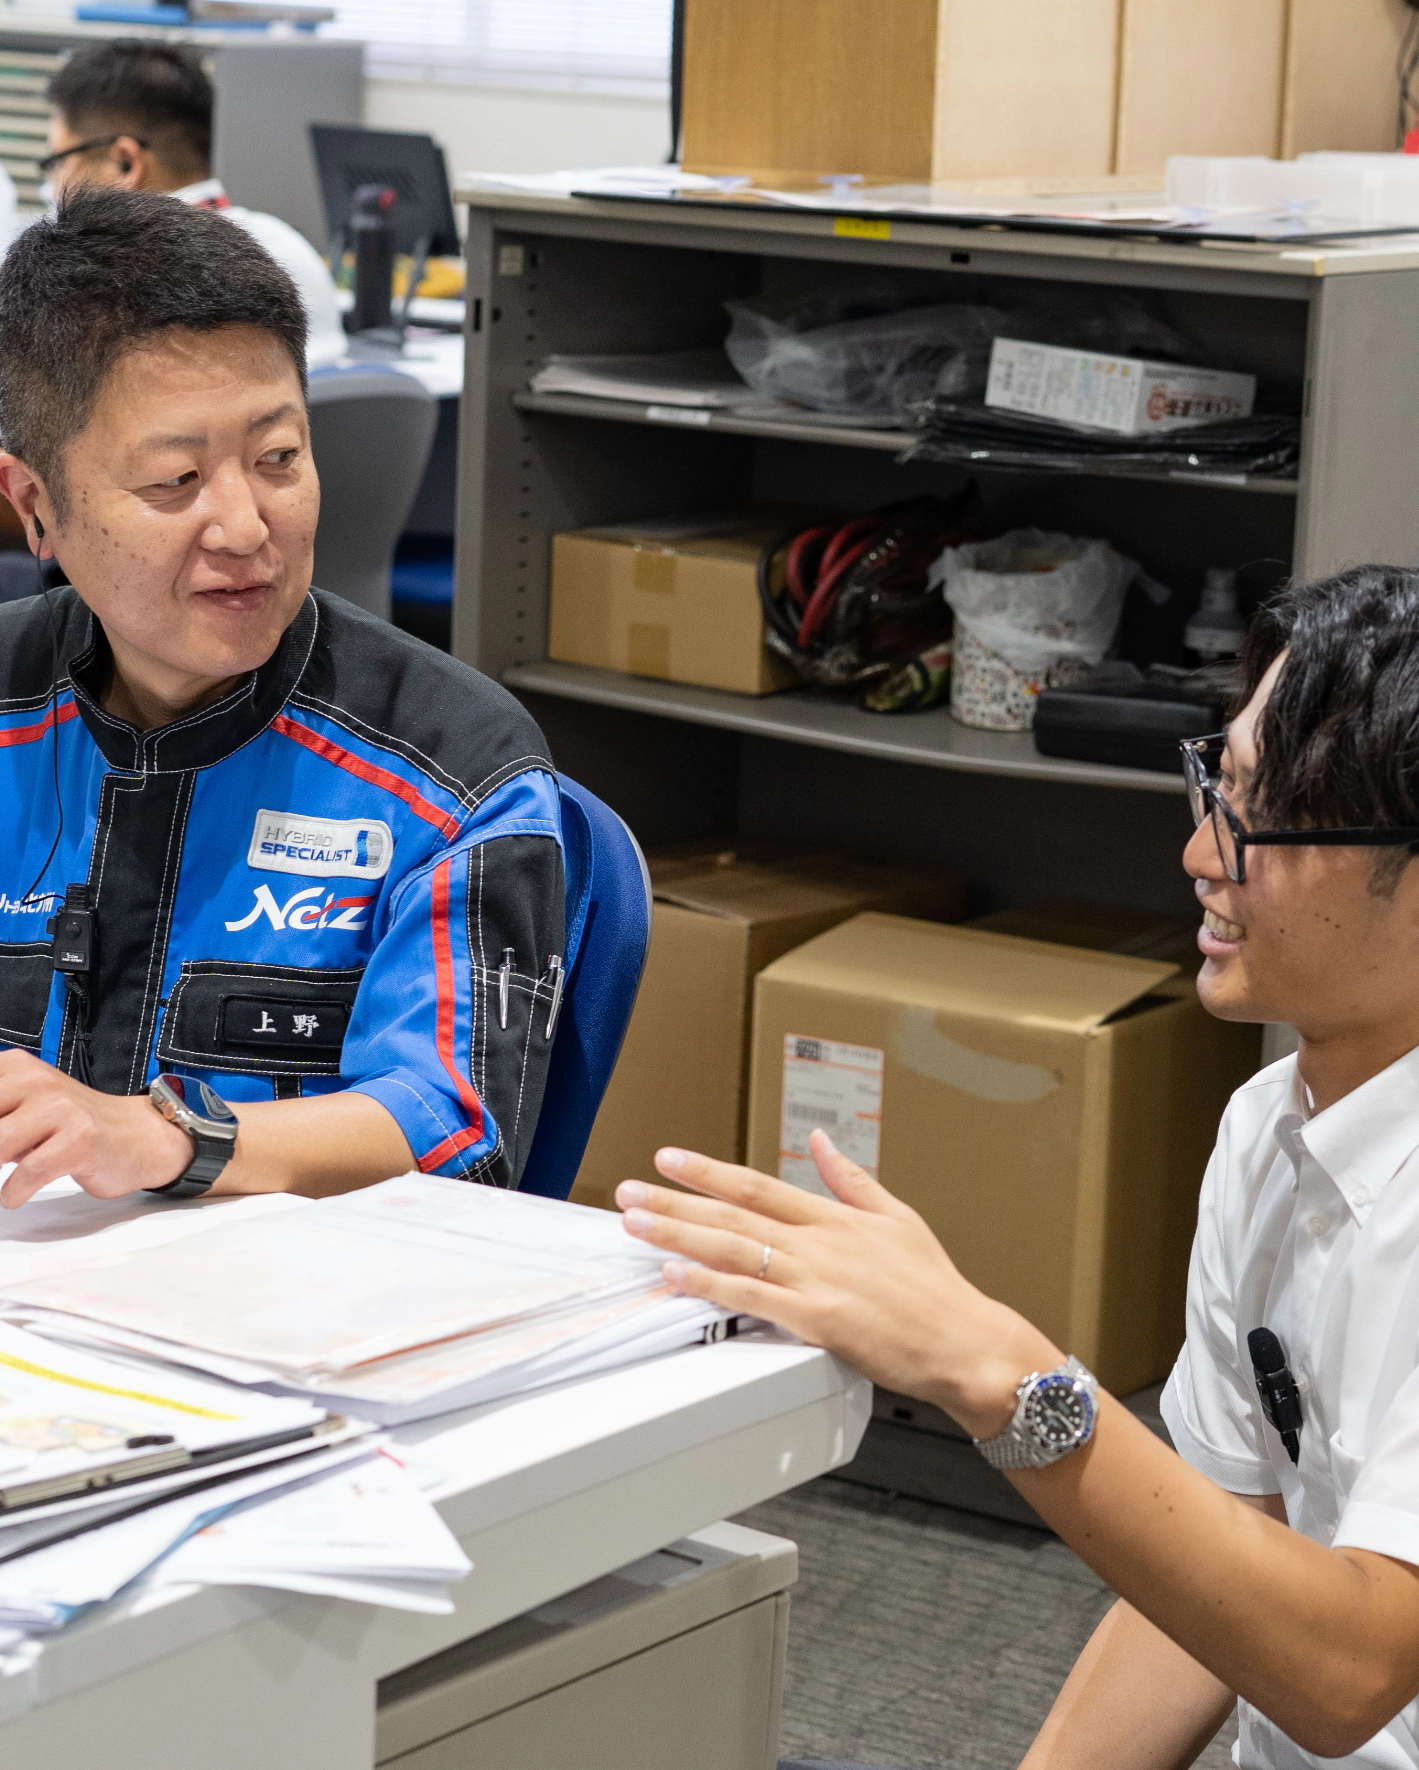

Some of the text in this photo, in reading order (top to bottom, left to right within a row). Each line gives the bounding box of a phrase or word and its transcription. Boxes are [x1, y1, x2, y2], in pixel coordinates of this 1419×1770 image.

[264, 826, 333, 847] HYBRID
[260, 841, 352, 862] SPECIALIST
[224, 883, 375, 932] Netz
